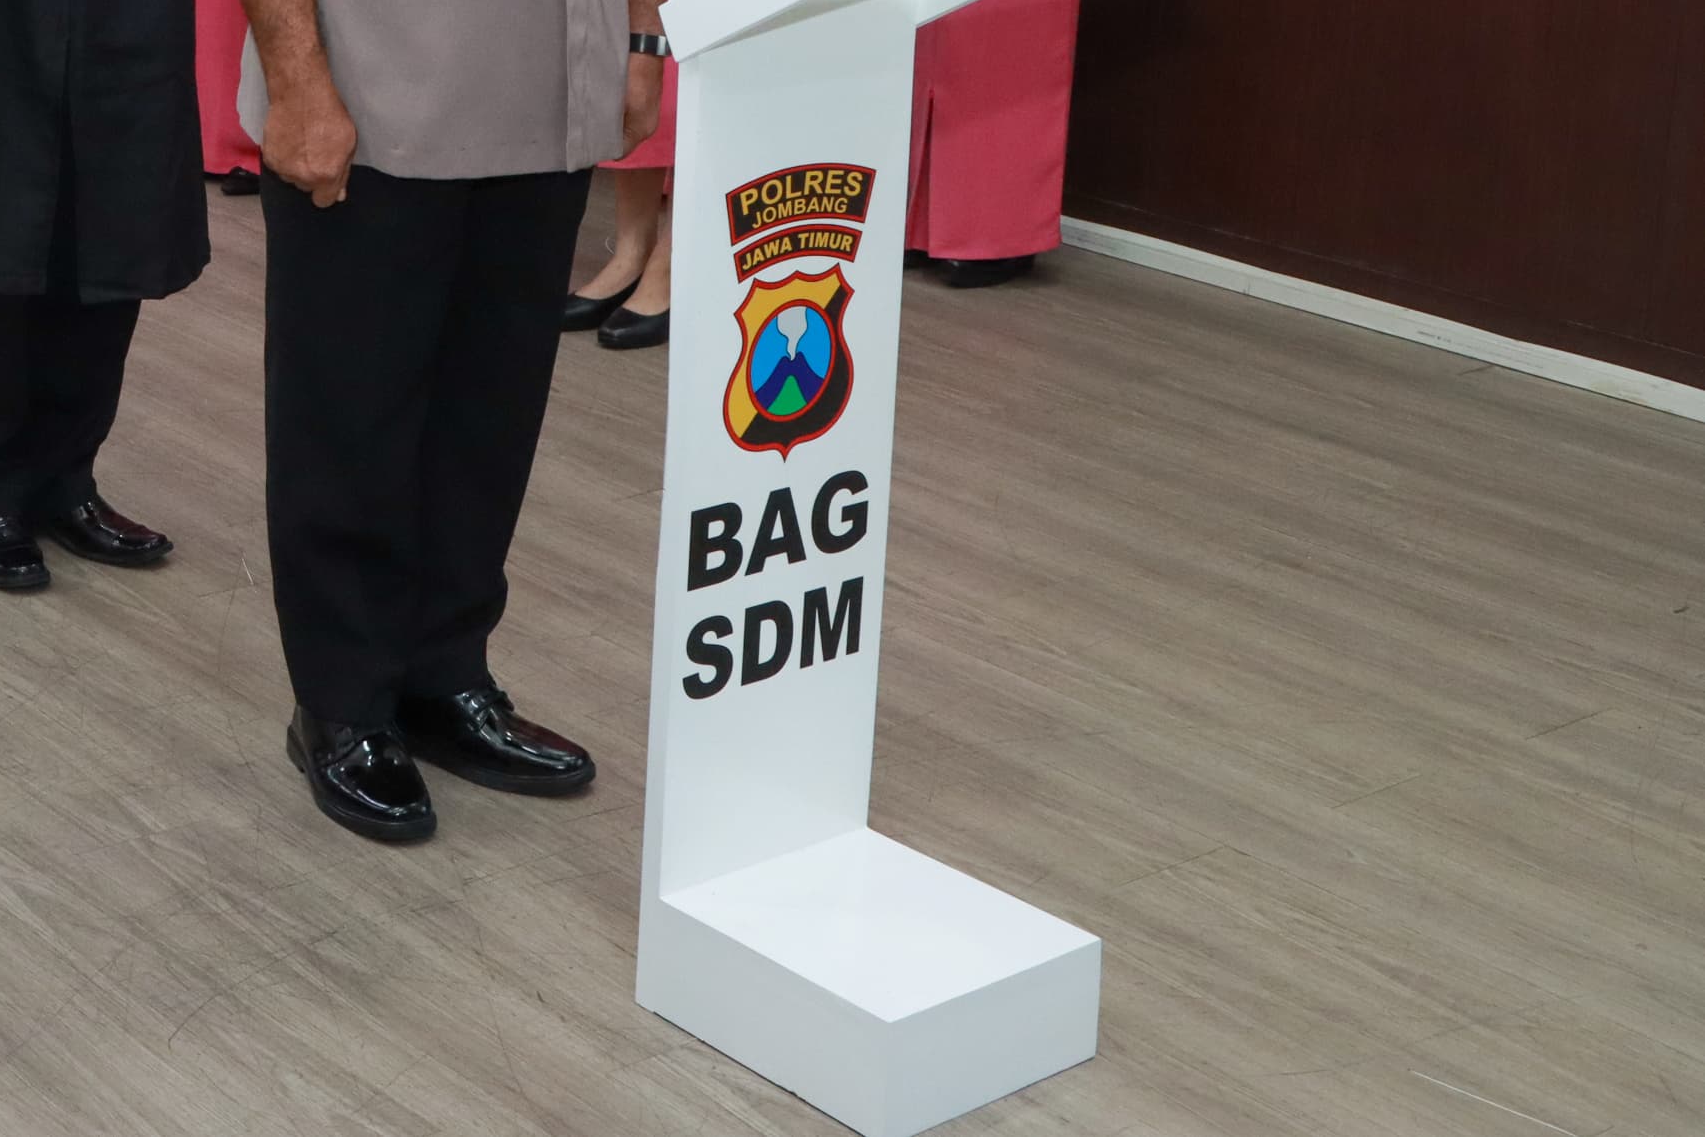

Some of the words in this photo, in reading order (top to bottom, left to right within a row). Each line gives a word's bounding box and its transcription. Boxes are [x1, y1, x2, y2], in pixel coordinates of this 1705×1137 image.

[740, 169, 864, 216] POLRES
[751, 196, 849, 229] JOMBANG
[741, 237, 793, 271] JAWA
[797, 231, 854, 252] TIMUR
[686, 470, 869, 592] BAG
[682, 576, 865, 700] SDM
